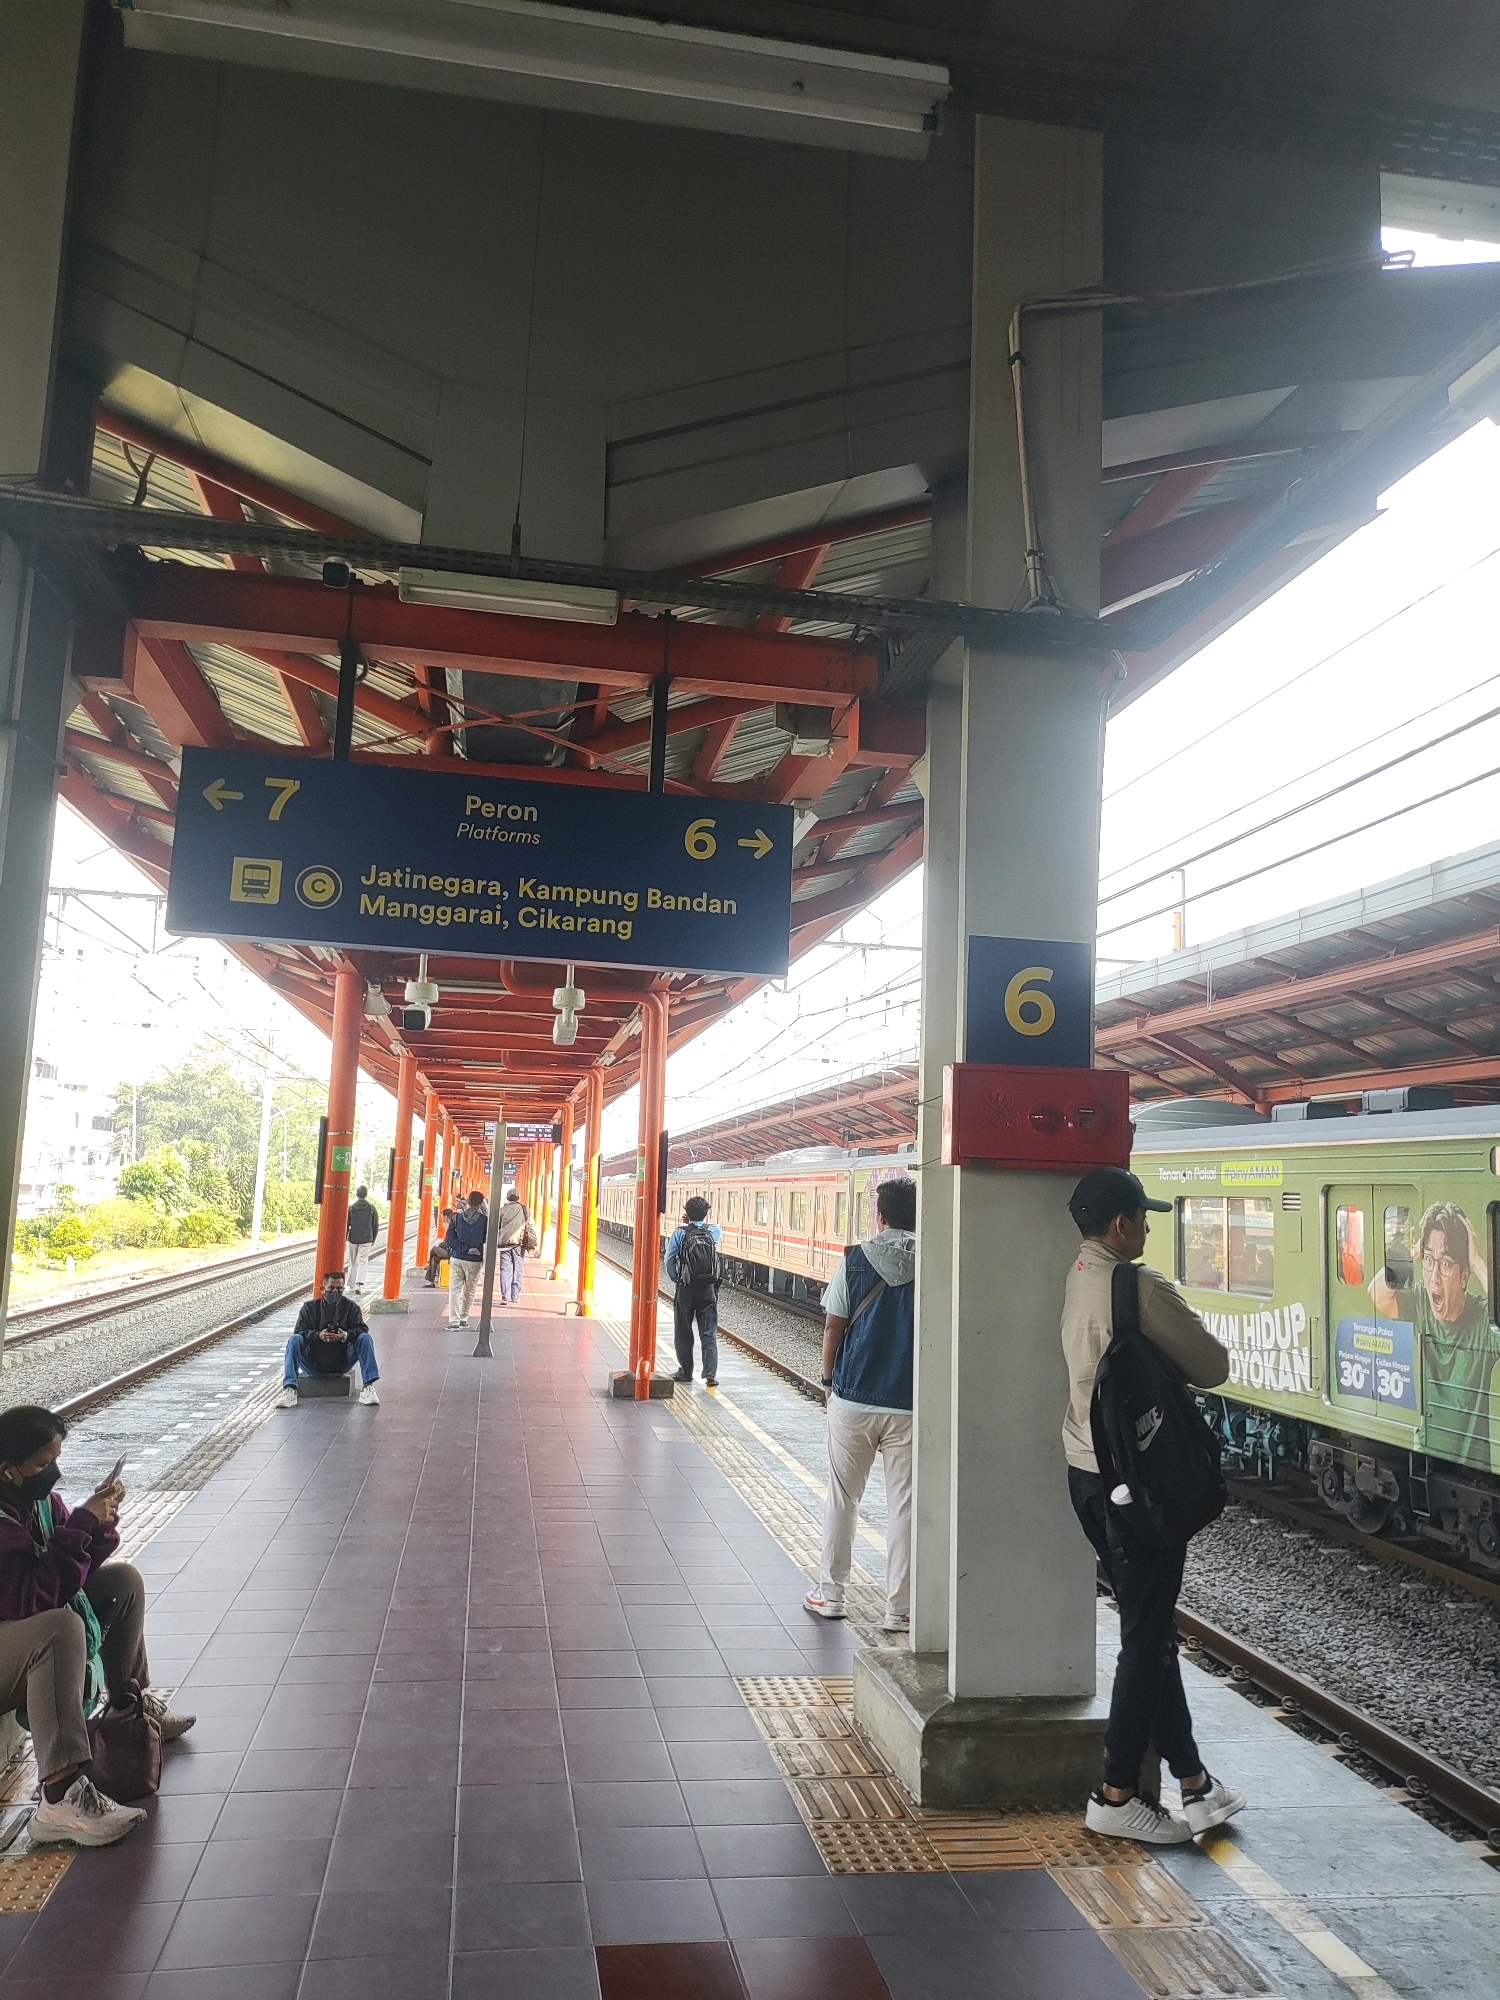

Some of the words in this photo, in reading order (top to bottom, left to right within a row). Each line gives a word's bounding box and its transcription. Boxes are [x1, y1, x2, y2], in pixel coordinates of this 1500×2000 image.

[264, 777, 301, 821] 7
[465, 795, 538, 822] Peron
[456, 822, 542, 845] Platforms
[684, 818, 717, 860] 6
[360, 864, 510, 901] Jatinegara,
[518, 877, 640, 912] Kampung
[646, 887, 738, 915] Bandan
[359, 893, 510, 930] Manggarai,
[517, 906, 633, 940] Cikarang
[1004, 966, 1056, 1037] 6
[1158, 1167, 1193, 1184] Tenangin
[1194, 1166, 1217, 1180] Pakai
[1224, 1165, 1279, 1182] #pinyAMAN
[1242, 1302, 1306, 1350] HIDUP
[1377, 1326, 1394, 1337] Pakai
[1229, 1347, 1313, 1392] OYOKAN
[1339, 1360, 1365, 1390] 30
[1376, 1368, 1404, 1399] 30
[1135, 1405, 1159, 1438] NIKE
